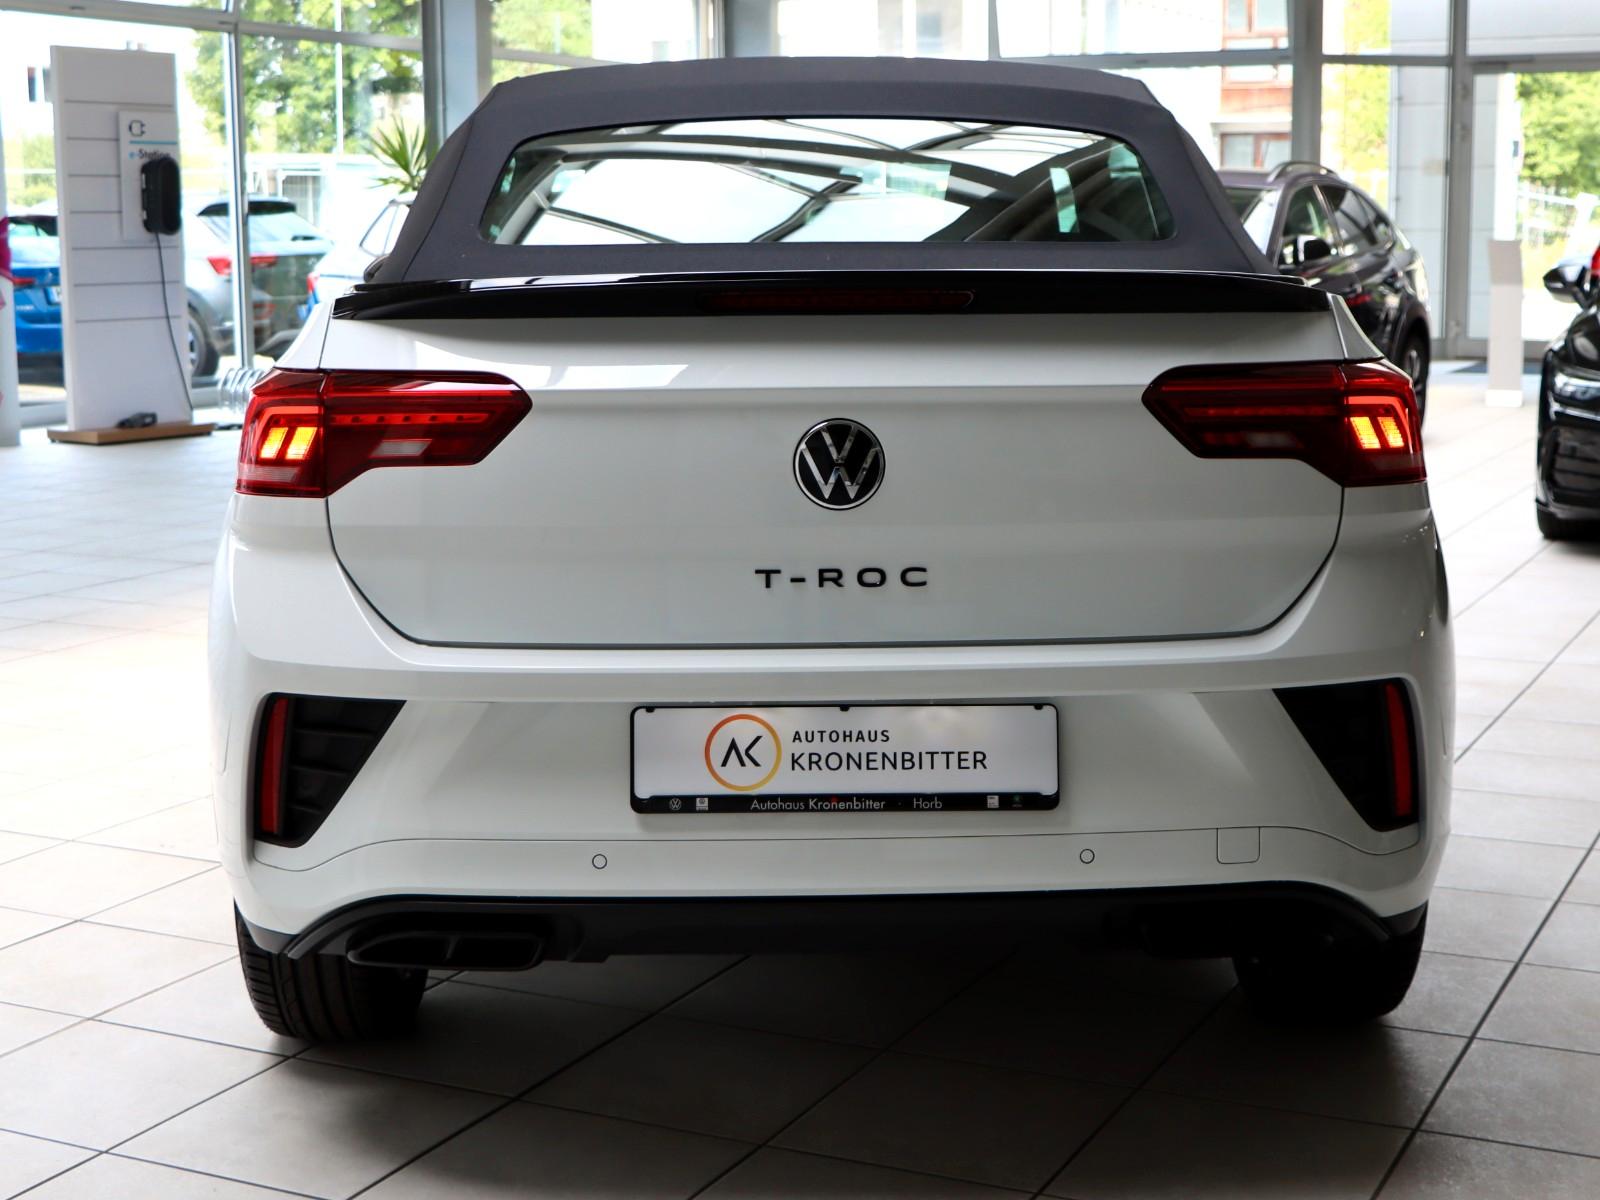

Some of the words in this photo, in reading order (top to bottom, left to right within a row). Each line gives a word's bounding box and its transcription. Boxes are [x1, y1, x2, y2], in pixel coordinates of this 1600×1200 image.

[794, 418, 886, 510] VW
[754, 567, 928, 589] T-ROC
[792, 730, 890, 743] AUTOHAUS
[720, 735, 763, 768] AK
[791, 751, 988, 771] KRONENBITTER
[750, 799, 805, 811] Autohaus
[808, 797, 886, 811] Kronenbitter
[913, 797, 943, 809] Horb
